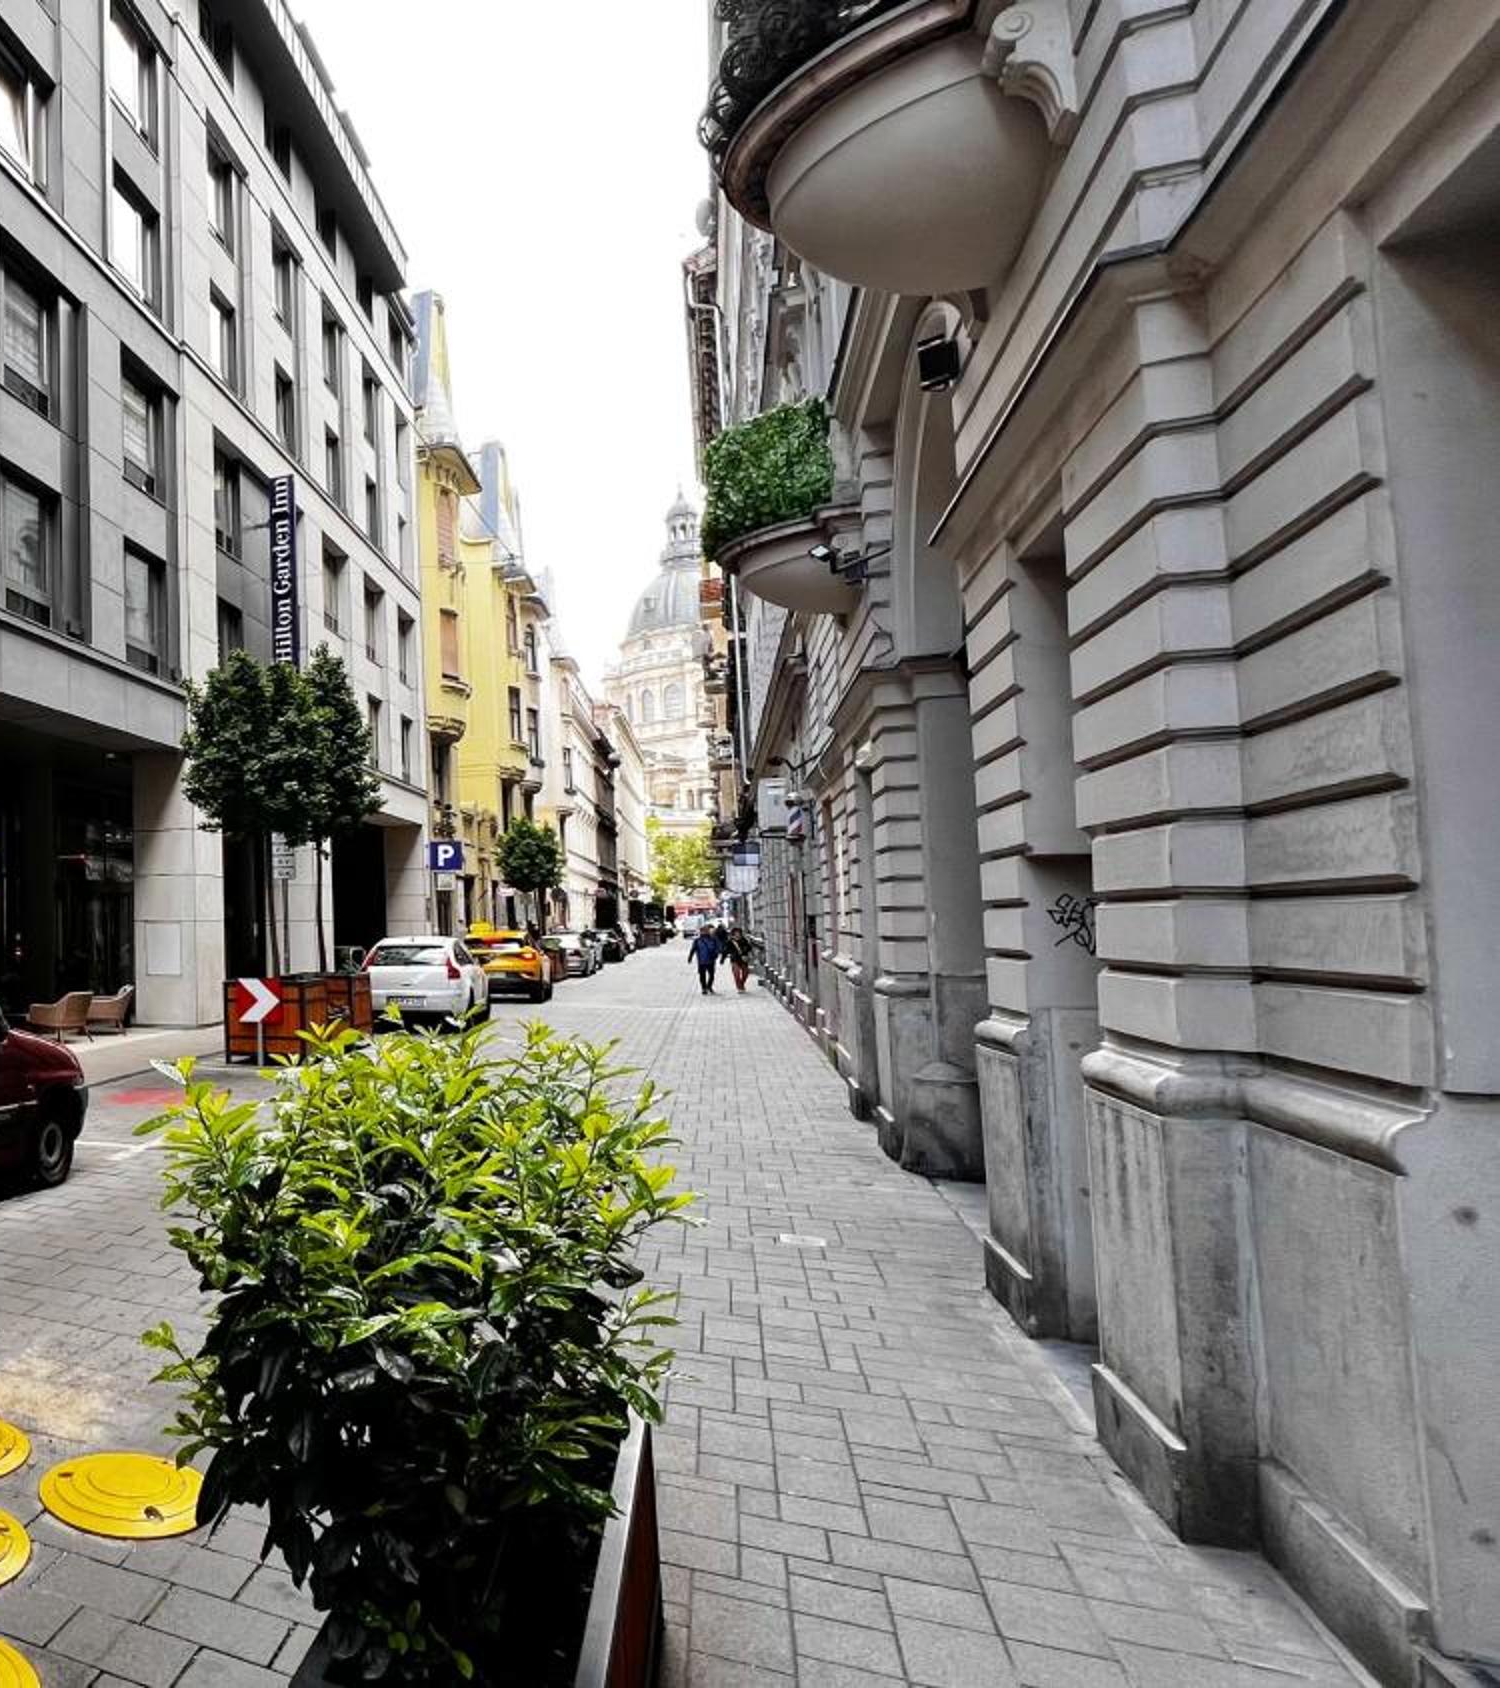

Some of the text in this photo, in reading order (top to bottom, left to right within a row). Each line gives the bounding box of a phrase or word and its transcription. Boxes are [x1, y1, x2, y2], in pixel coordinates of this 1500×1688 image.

[271, 477, 293, 664] Hilton Garden Inn
[436, 843, 455, 867] P
